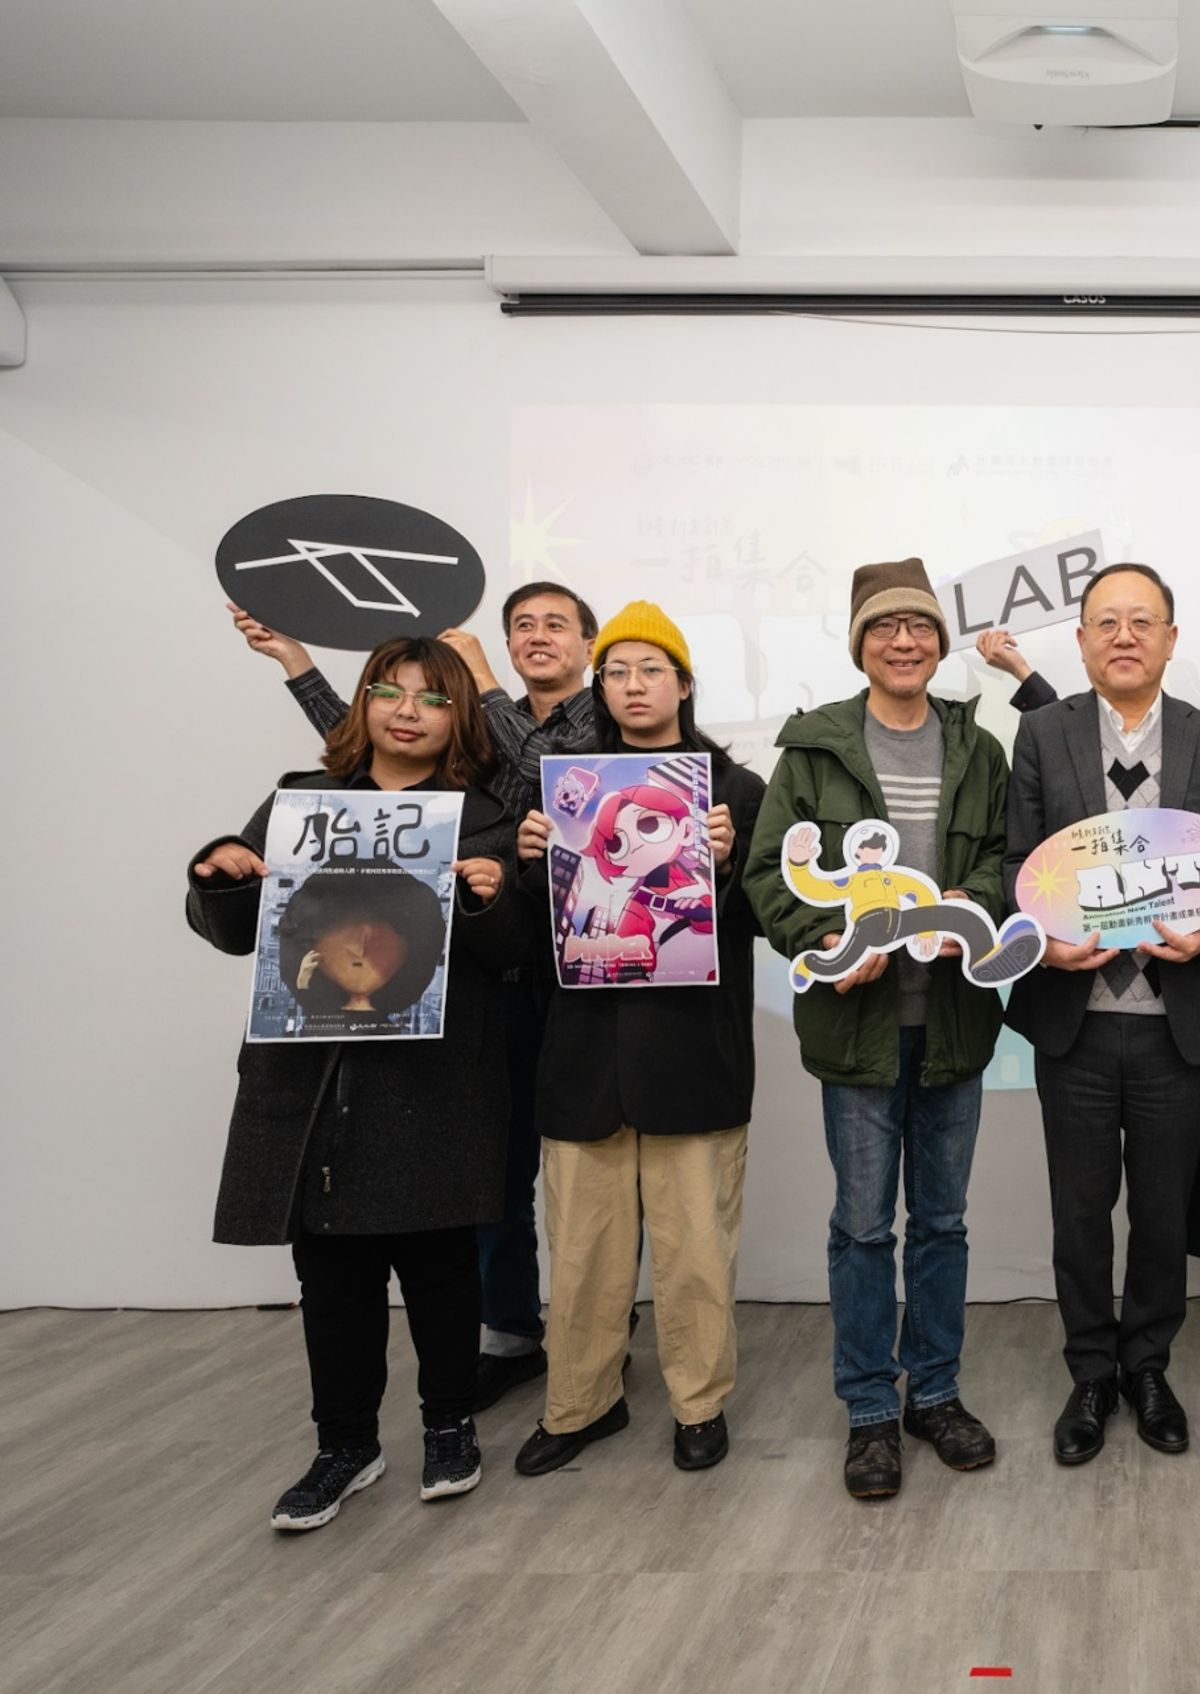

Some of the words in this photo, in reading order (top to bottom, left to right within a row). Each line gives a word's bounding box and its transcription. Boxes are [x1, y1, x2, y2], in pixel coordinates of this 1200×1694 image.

[953, 546, 1100, 636] LAB
[292, 803, 431, 862] 胎記
[1127, 905, 1147, 914] New
[1148, 897, 1176, 910] Talent
